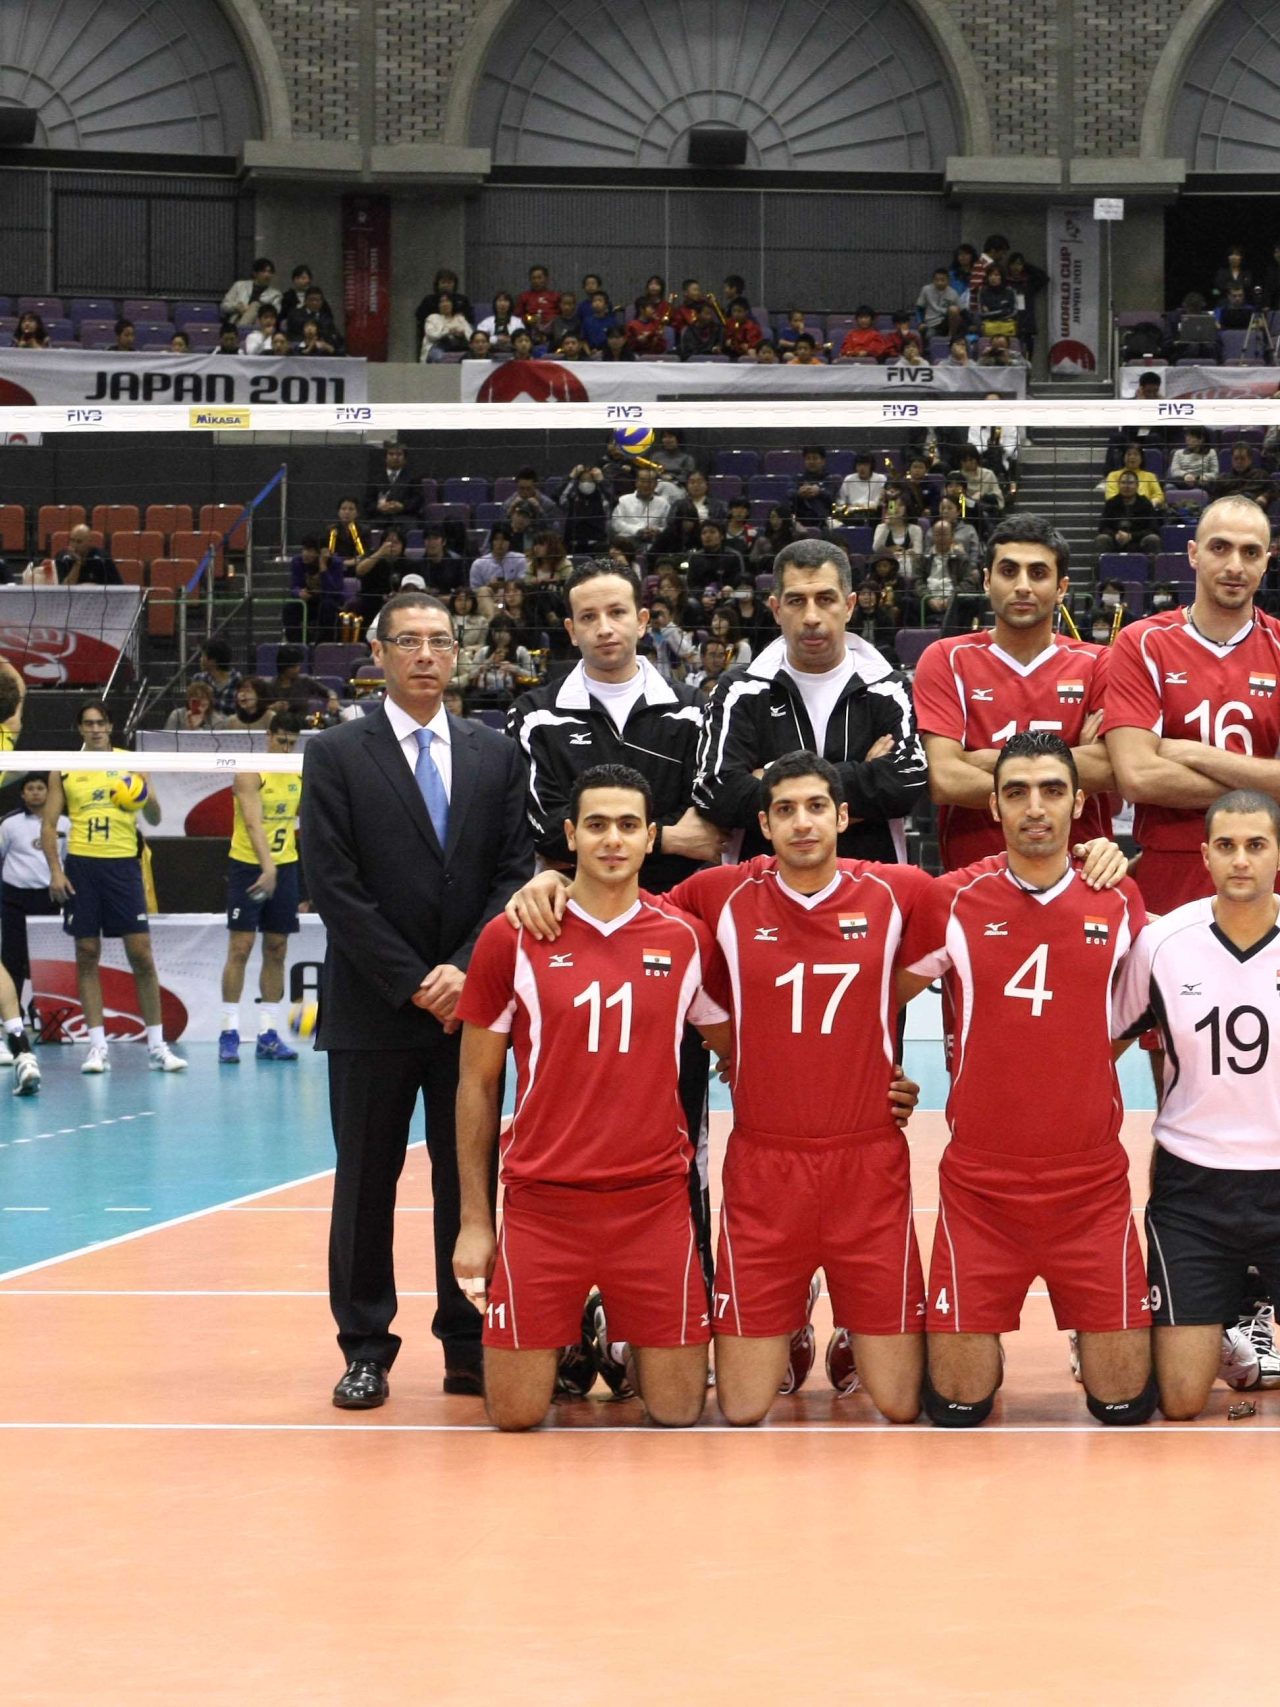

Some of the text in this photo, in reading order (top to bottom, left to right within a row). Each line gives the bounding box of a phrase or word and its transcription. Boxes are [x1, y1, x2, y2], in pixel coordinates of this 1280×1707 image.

[1060, 246, 1073, 338] WORLD CUP
[85, 371, 345, 404] JAPAN 2011
[887, 367, 934, 383] FIVB
[67, 409, 103, 422] FIVB
[336, 407, 372, 420] FIVB
[607, 406, 643, 418] FIVB
[883, 405, 919, 417] FIVB
[1158, 403, 1194, 415] FIVB
[1184, 699, 1254, 757] 16
[88, 816, 109, 842] 14
[271, 828, 287, 853] 5
[843, 932, 867, 940] EGY
[1086, 937, 1107, 946] EGY
[645, 969, 669, 978] EGY
[1004, 944, 1053, 1017] 4
[775, 962, 861, 1034] 17
[573, 981, 633, 1053] 11
[1195, 1005, 1269, 1075] 19
[935, 1287, 949, 1314] 4
[486, 1303, 506, 1329] 11
